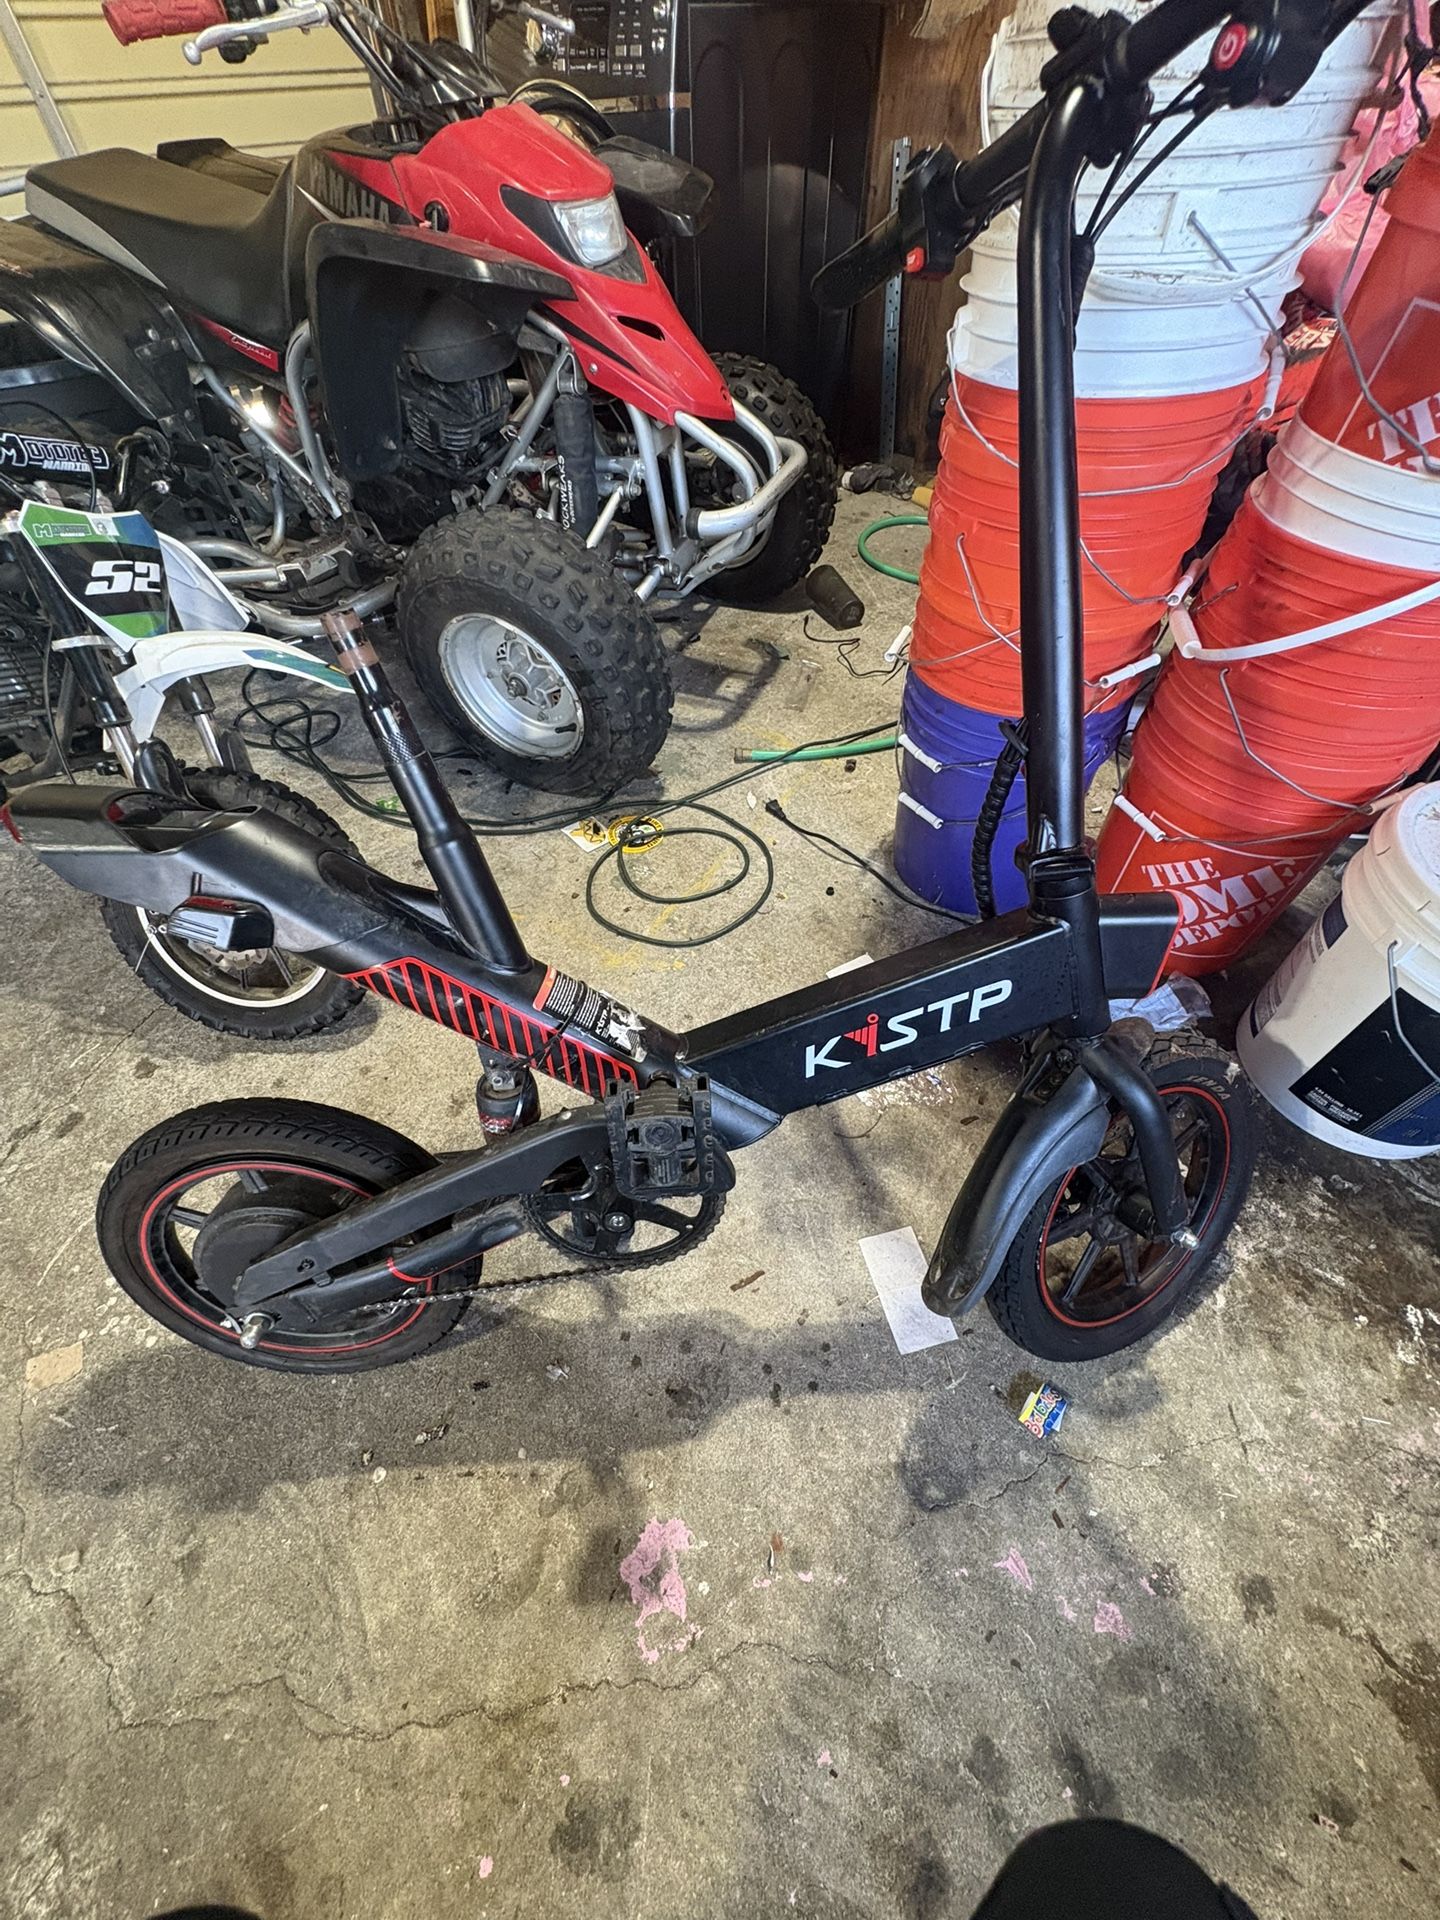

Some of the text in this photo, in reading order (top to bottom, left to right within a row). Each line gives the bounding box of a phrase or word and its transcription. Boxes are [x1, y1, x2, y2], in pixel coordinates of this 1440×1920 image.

[307, 152, 390, 223] YAMAHA
[558, 455, 570, 530] OCKWEARS
[85, 560, 161, 595] 52
[1141, 857, 1221, 888] THE
